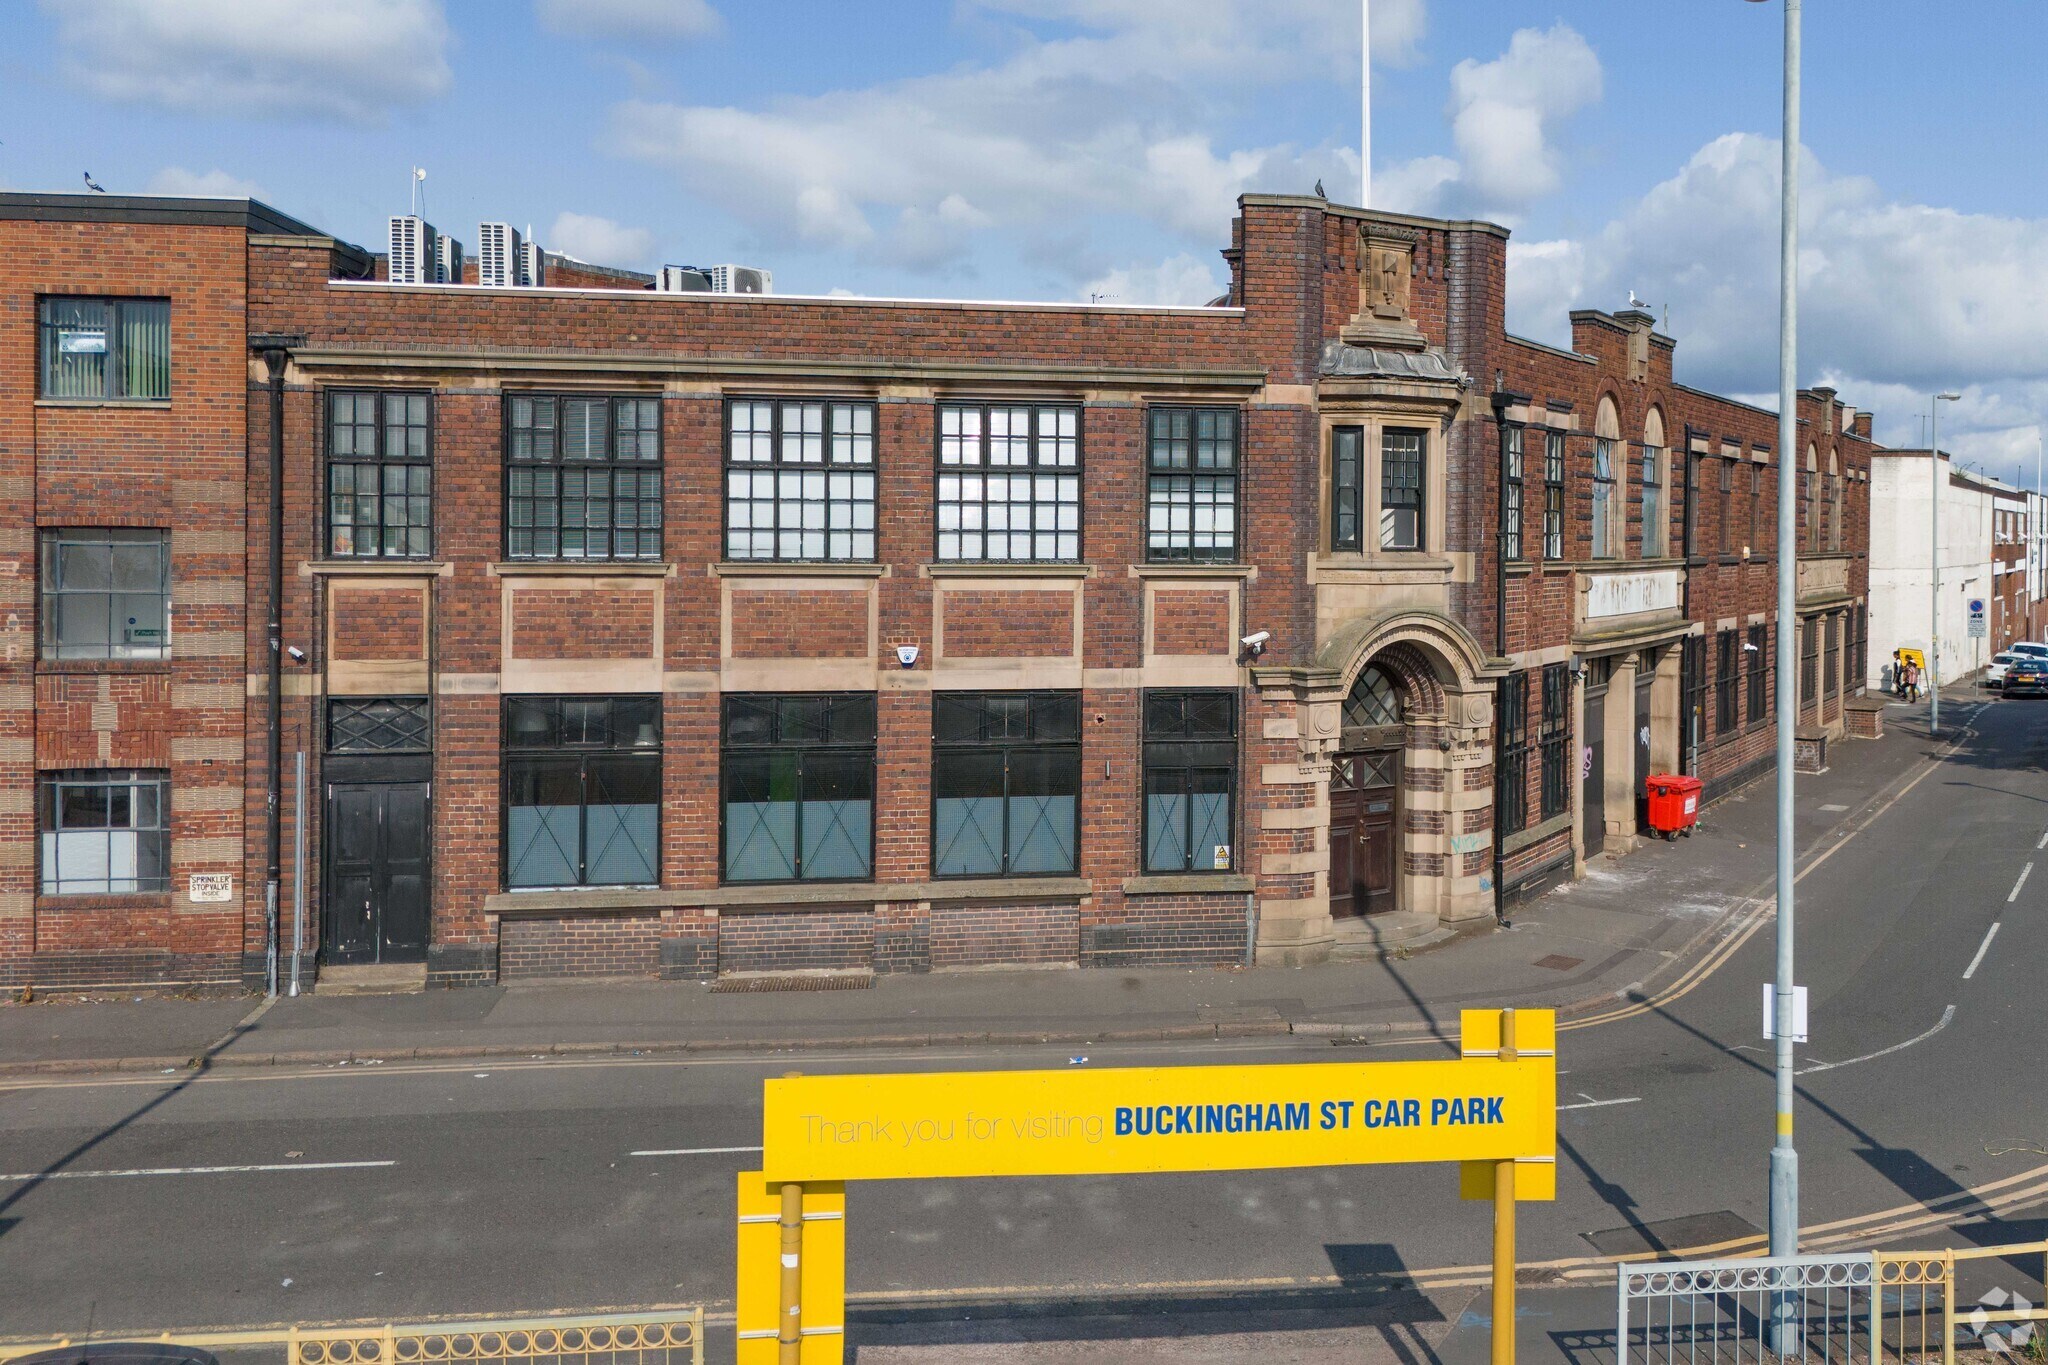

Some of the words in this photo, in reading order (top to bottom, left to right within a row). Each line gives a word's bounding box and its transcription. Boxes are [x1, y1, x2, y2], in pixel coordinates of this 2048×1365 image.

[192, 876, 230, 884] SPRINKLER
[799, 1113, 893, 1144] Thank
[900, 1118, 954, 1148] you
[965, 1111, 1003, 1140] for
[1010, 1109, 1103, 1144] visiting
[1114, 1101, 1310, 1136] BUCKINGHAM
[1319, 1100, 1355, 1130] ST
[1363, 1098, 1421, 1129] CAR
[1430, 1096, 1505, 1126] PARK
